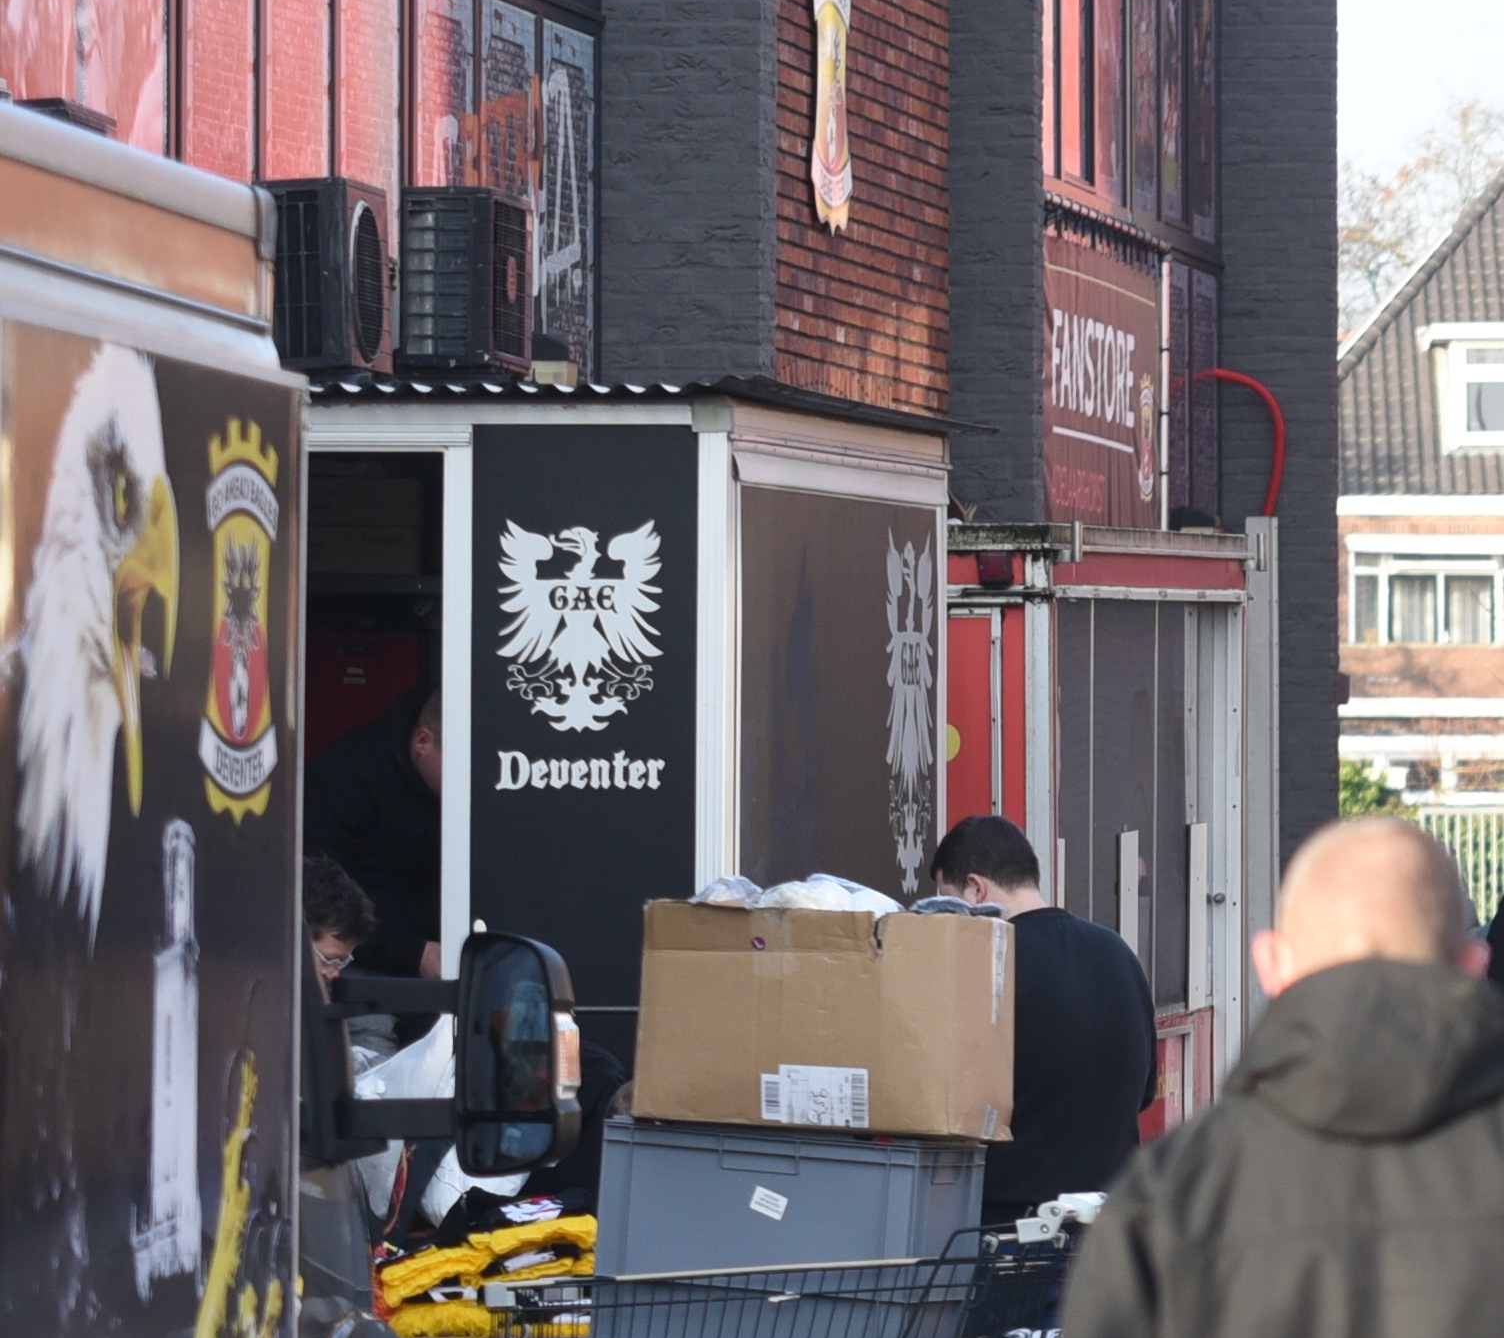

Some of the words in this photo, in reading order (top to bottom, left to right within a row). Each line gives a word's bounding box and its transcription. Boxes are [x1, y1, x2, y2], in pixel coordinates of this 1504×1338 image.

[1051, 309, 1135, 428] FANSTORE
[549, 585, 618, 614] GAE
[215, 747, 266, 788] DEVENTER
[494, 750, 667, 791] Deventer
